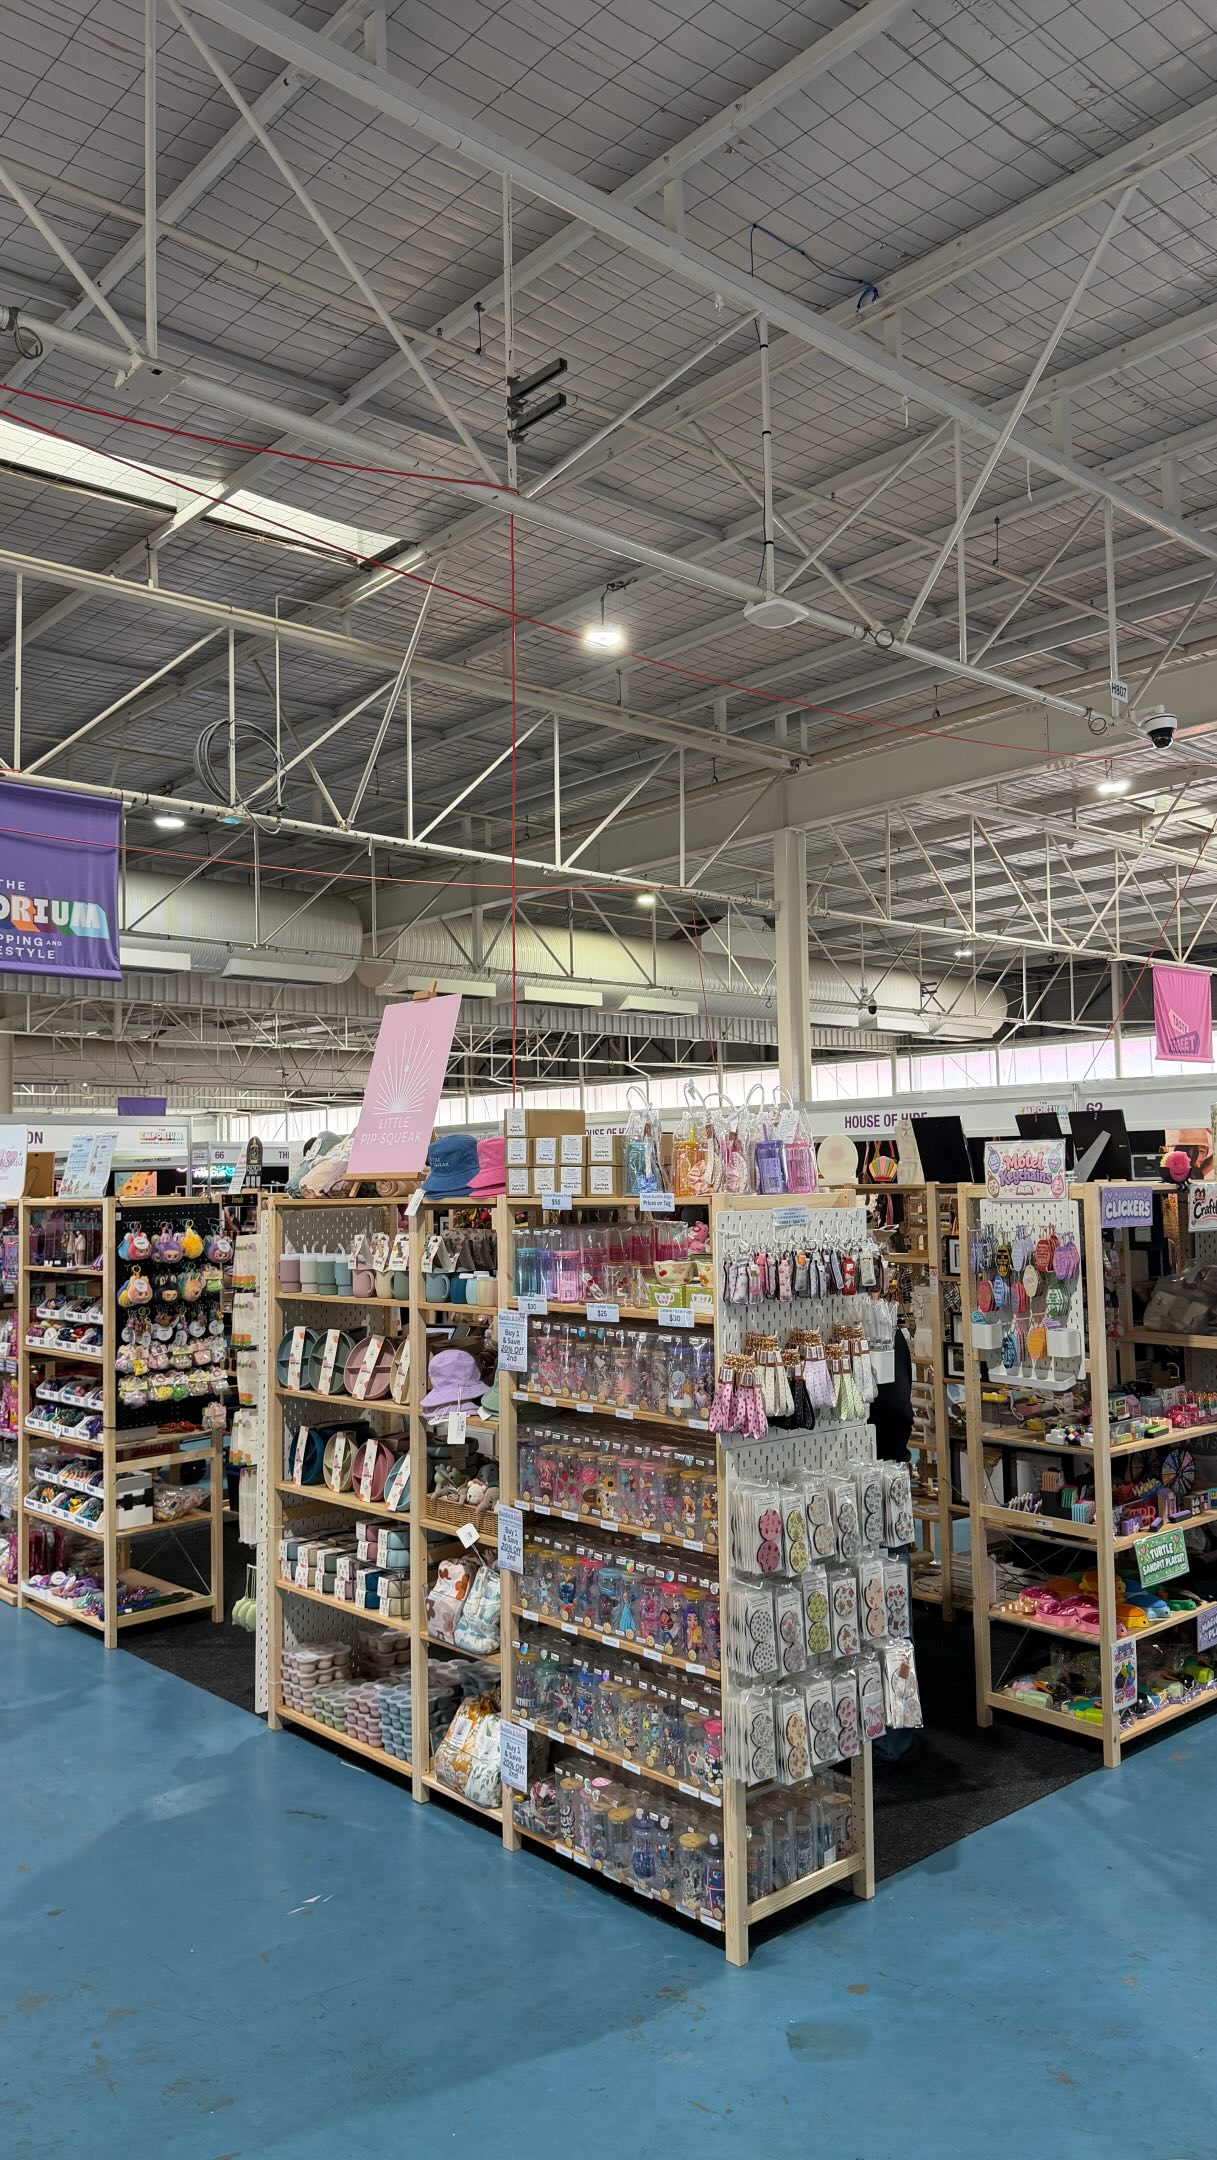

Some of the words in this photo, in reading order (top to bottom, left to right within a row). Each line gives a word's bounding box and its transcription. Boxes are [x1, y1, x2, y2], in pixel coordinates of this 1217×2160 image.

[47, 940, 62, 948] AND
[1172, 1015, 1188, 1033] TASTE
[379, 1117, 409, 1130] LITTLE
[845, 1115, 880, 1129] HOUSE
[884, 1113, 898, 1127] OF
[360, 1131, 422, 1146] PIP-SQUEAK
[214, 1151, 225, 1160] 66
[1003, 1150, 1045, 1171] Motel
[999, 1169, 1053, 1187] Keychains
[1104, 1199, 1152, 1219] CLICKERS
[1194, 1198, 1217, 1219] Craft
[505, 1329, 515, 1338] Buy
[508, 1337, 520, 1345] Save
[501, 1345, 513, 1353] 20%
[514, 1346, 524, 1354] Off
[505, 1527, 514, 1536] Buy
[507, 1536, 519, 1545] Save
[501, 1542, 513, 1553] 20%
[513, 1546, 521, 1555] Off
[1149, 1543, 1174, 1561] TURTLE
[507, 1553, 516, 1561] 2nd
[1142, 1558, 1165, 1576] SANDPIT
[1165, 1552, 1185, 1568] PLAYSET
[506, 1742, 516, 1754] Buy
[509, 1752, 522, 1763] Save
[502, 1758, 515, 1769] 20%
[515, 1764, 525, 1773] Off
[508, 1769, 518, 1779] 2nd
